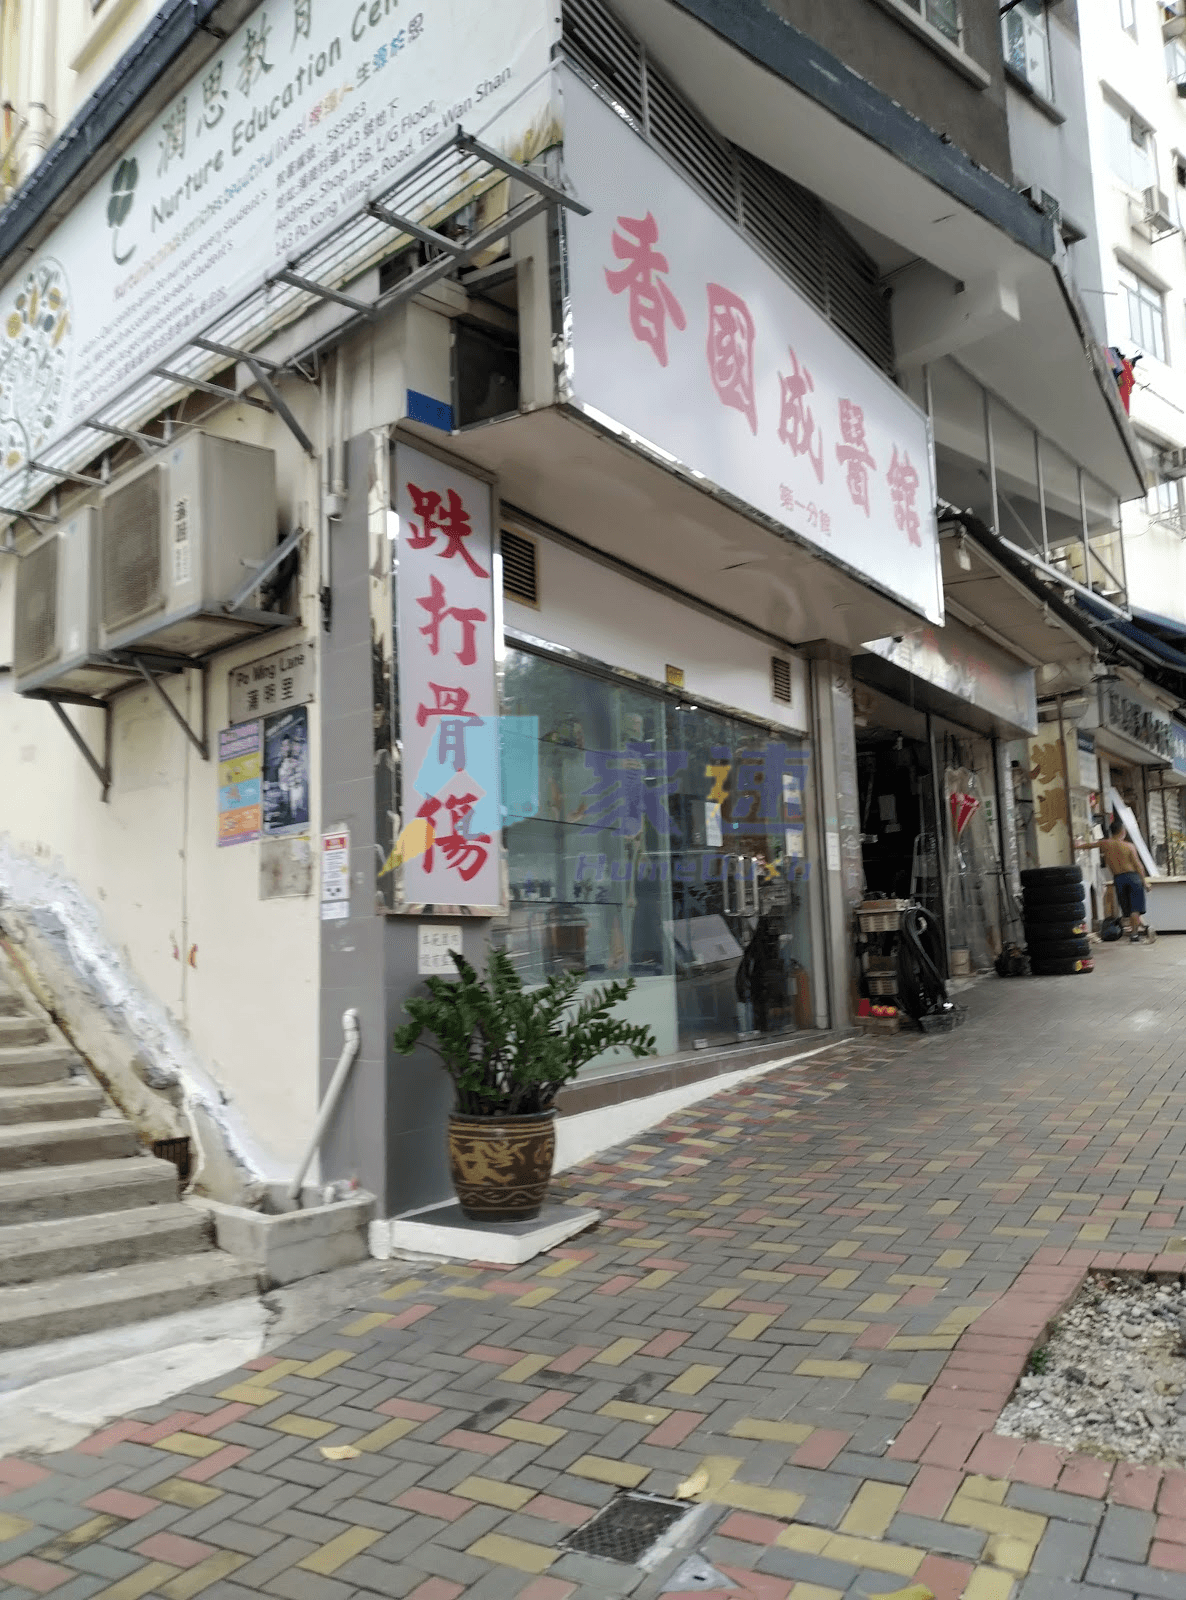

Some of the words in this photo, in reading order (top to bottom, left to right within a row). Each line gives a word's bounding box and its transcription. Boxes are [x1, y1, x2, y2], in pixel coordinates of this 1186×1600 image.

[151, 149, 224, 232] Nurture
[232, 36, 342, 157] Education
[310, 201, 338, 230] Kong
[340, 168, 379, 205] Village
[418, 121, 439, 146] Tsz
[441, 97, 472, 128] Wan
[475, 67, 511, 103] Shan
[318, 168, 347, 199] Shop
[279, 654, 304, 672] Lane
[406, 482, 491, 881] 跌打骨傷
